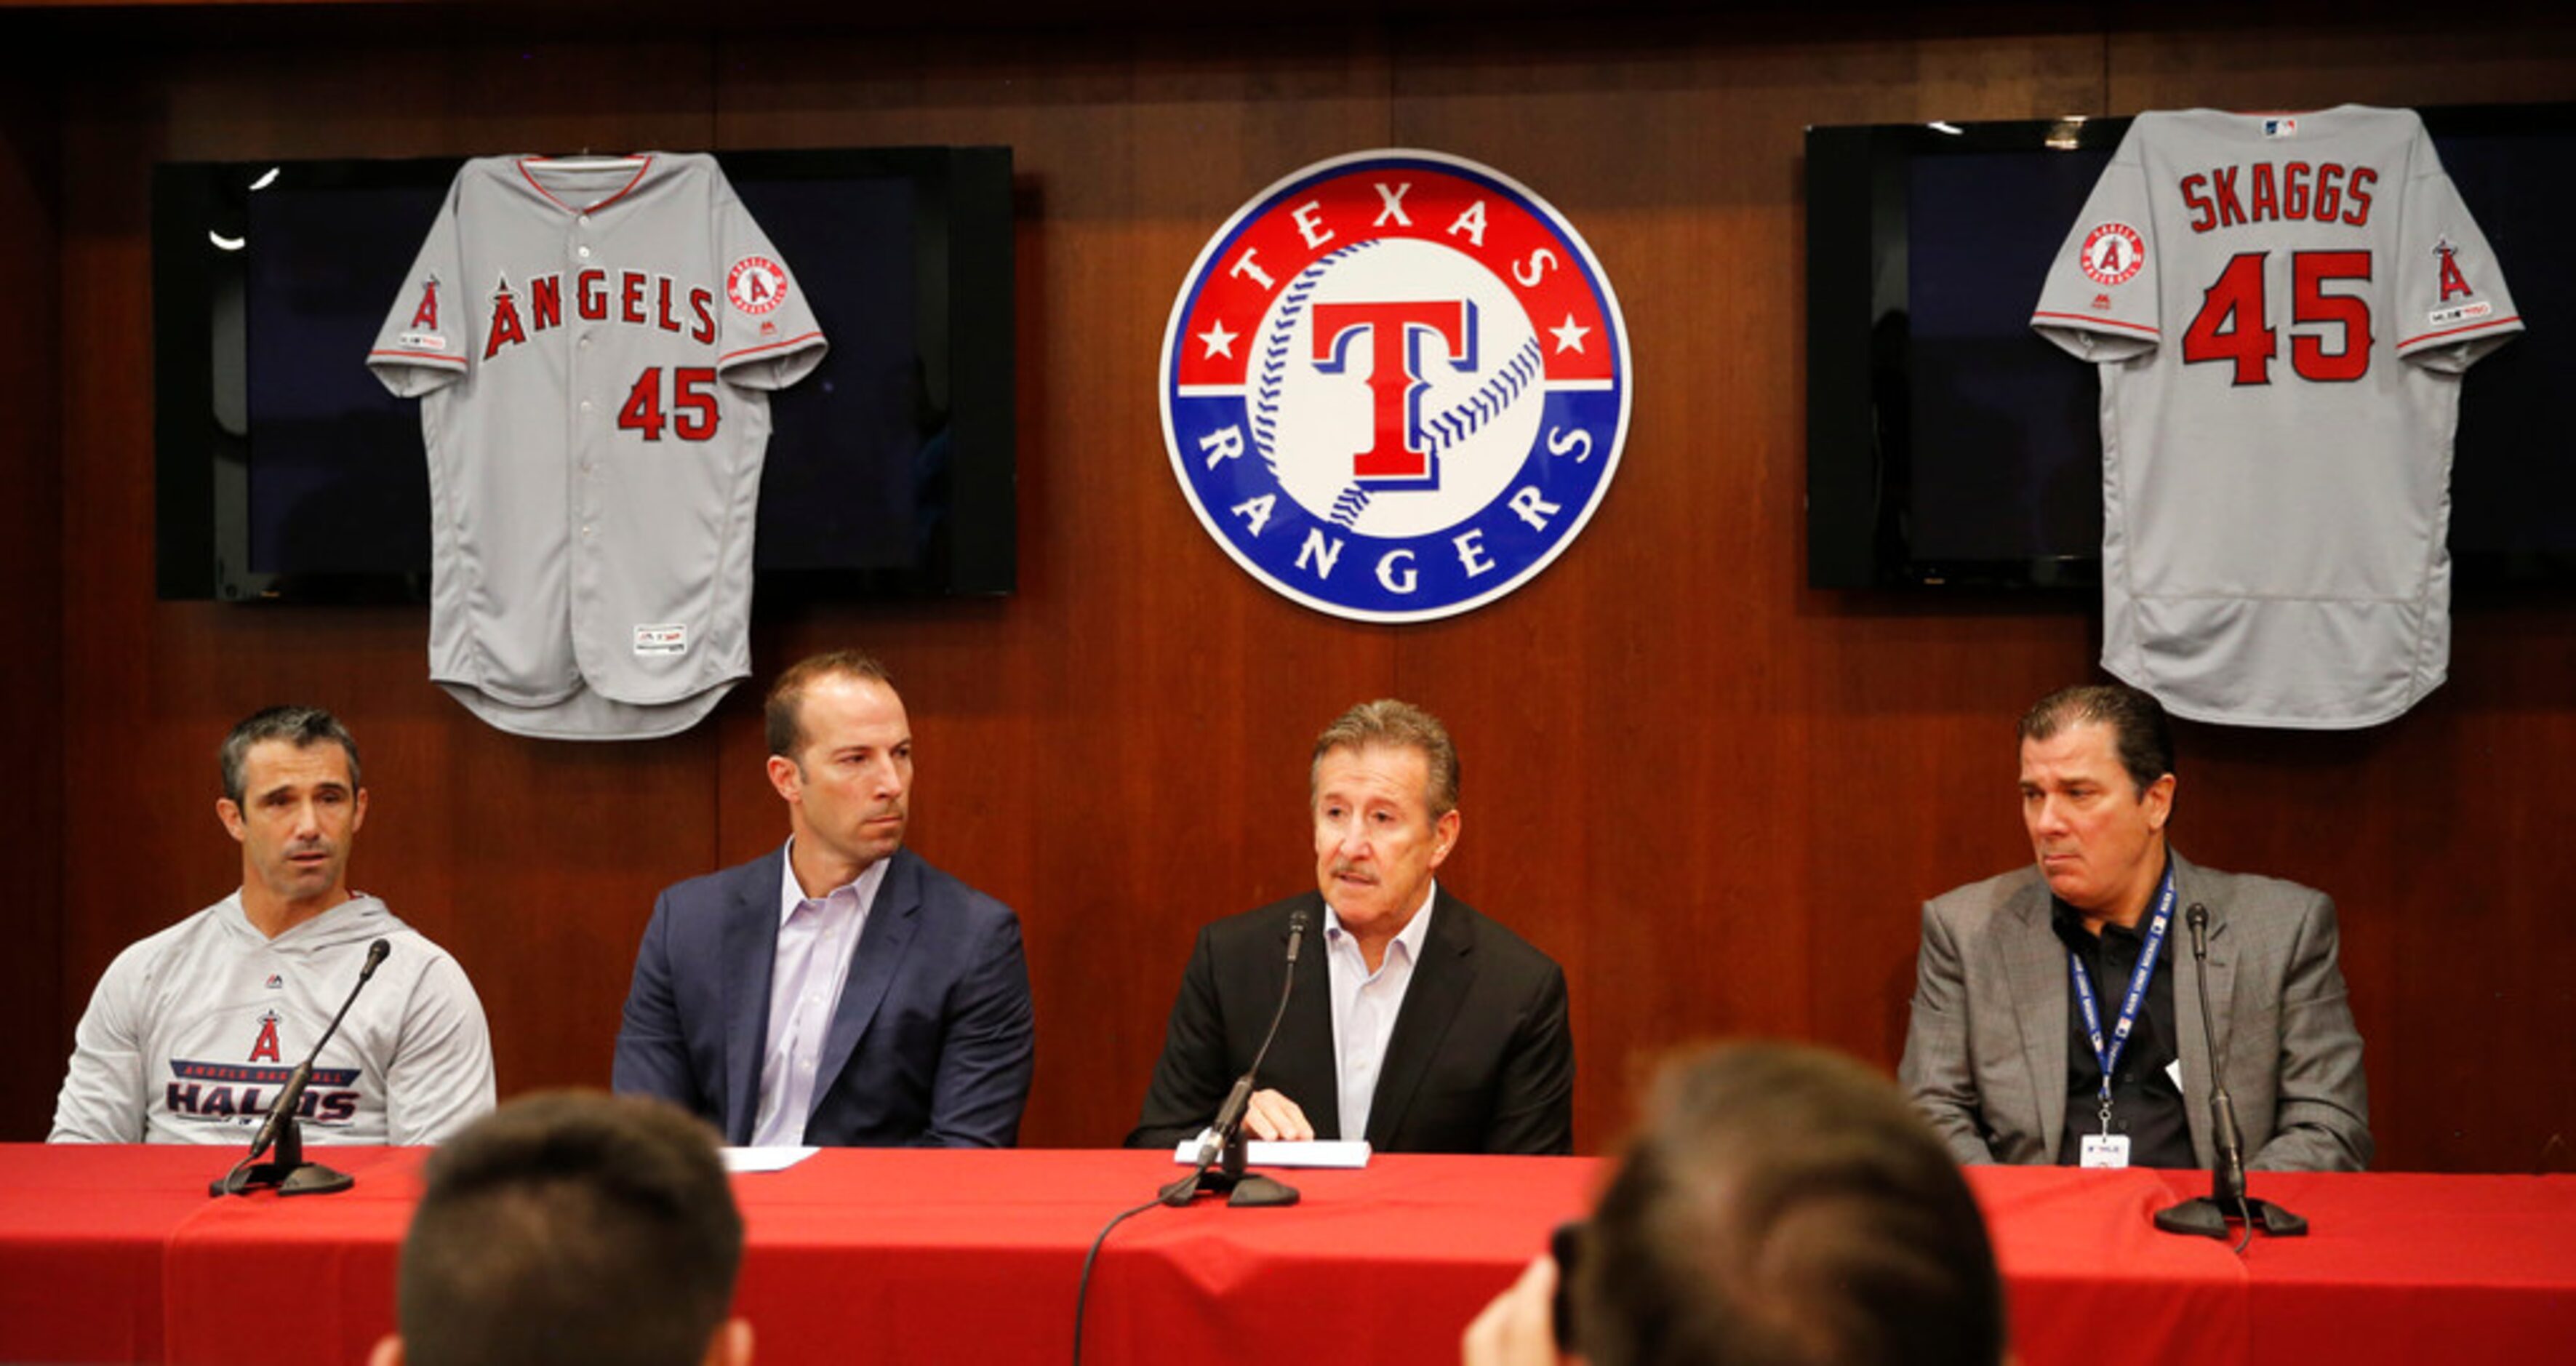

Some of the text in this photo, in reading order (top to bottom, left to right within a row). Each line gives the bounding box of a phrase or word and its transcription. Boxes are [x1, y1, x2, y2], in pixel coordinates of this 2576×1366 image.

[1229, 183, 1558, 290] TEXAS
[2180, 161, 2378, 233] SKAGGS
[411, 273, 441, 329] A
[2433, 239, 2473, 302] A
[483, 269, 716, 362] ANGELS
[2182, 249, 2375, 386] 45
[617, 366, 720, 442] 45
[1312, 298, 1479, 492] T
[1199, 423, 1593, 594] RANGERS
[248, 1010, 281, 1062] A
